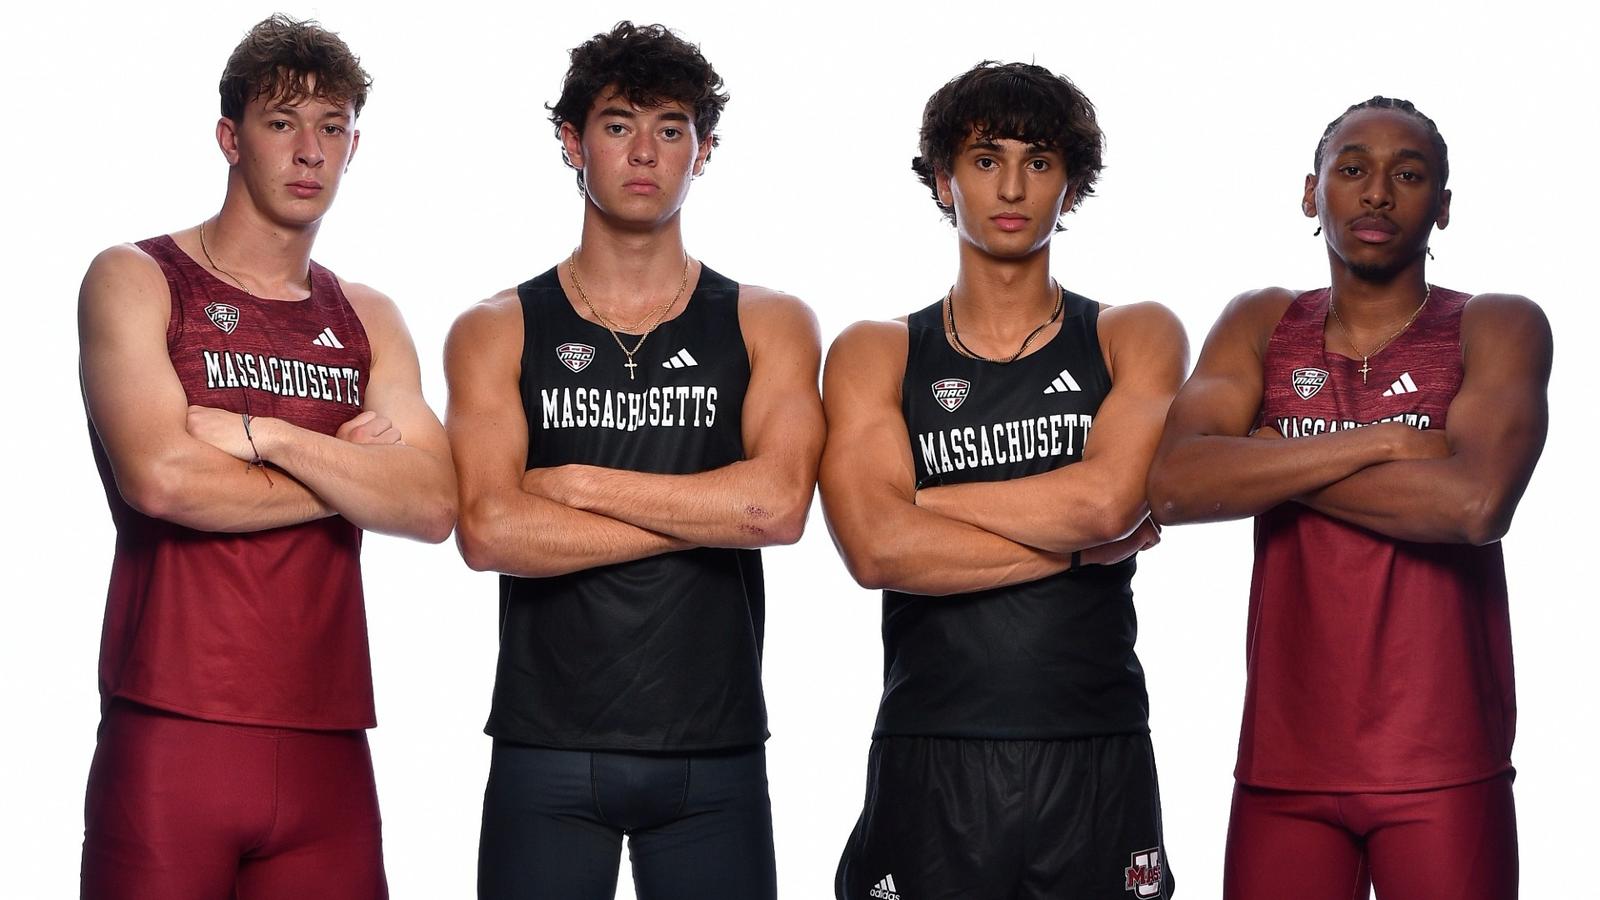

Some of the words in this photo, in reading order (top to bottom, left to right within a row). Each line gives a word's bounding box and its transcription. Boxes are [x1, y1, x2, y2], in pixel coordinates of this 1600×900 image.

[561, 352, 592, 361] MAC
[203, 350, 361, 407] MASSACHUSETTS
[1294, 377, 1324, 385] MAC
[936, 388, 967, 398] MAC
[918, 414, 1092, 475] MASSACHUSETT
[1126, 866, 1161, 889] MAS
[870, 889, 900, 900] adidas
